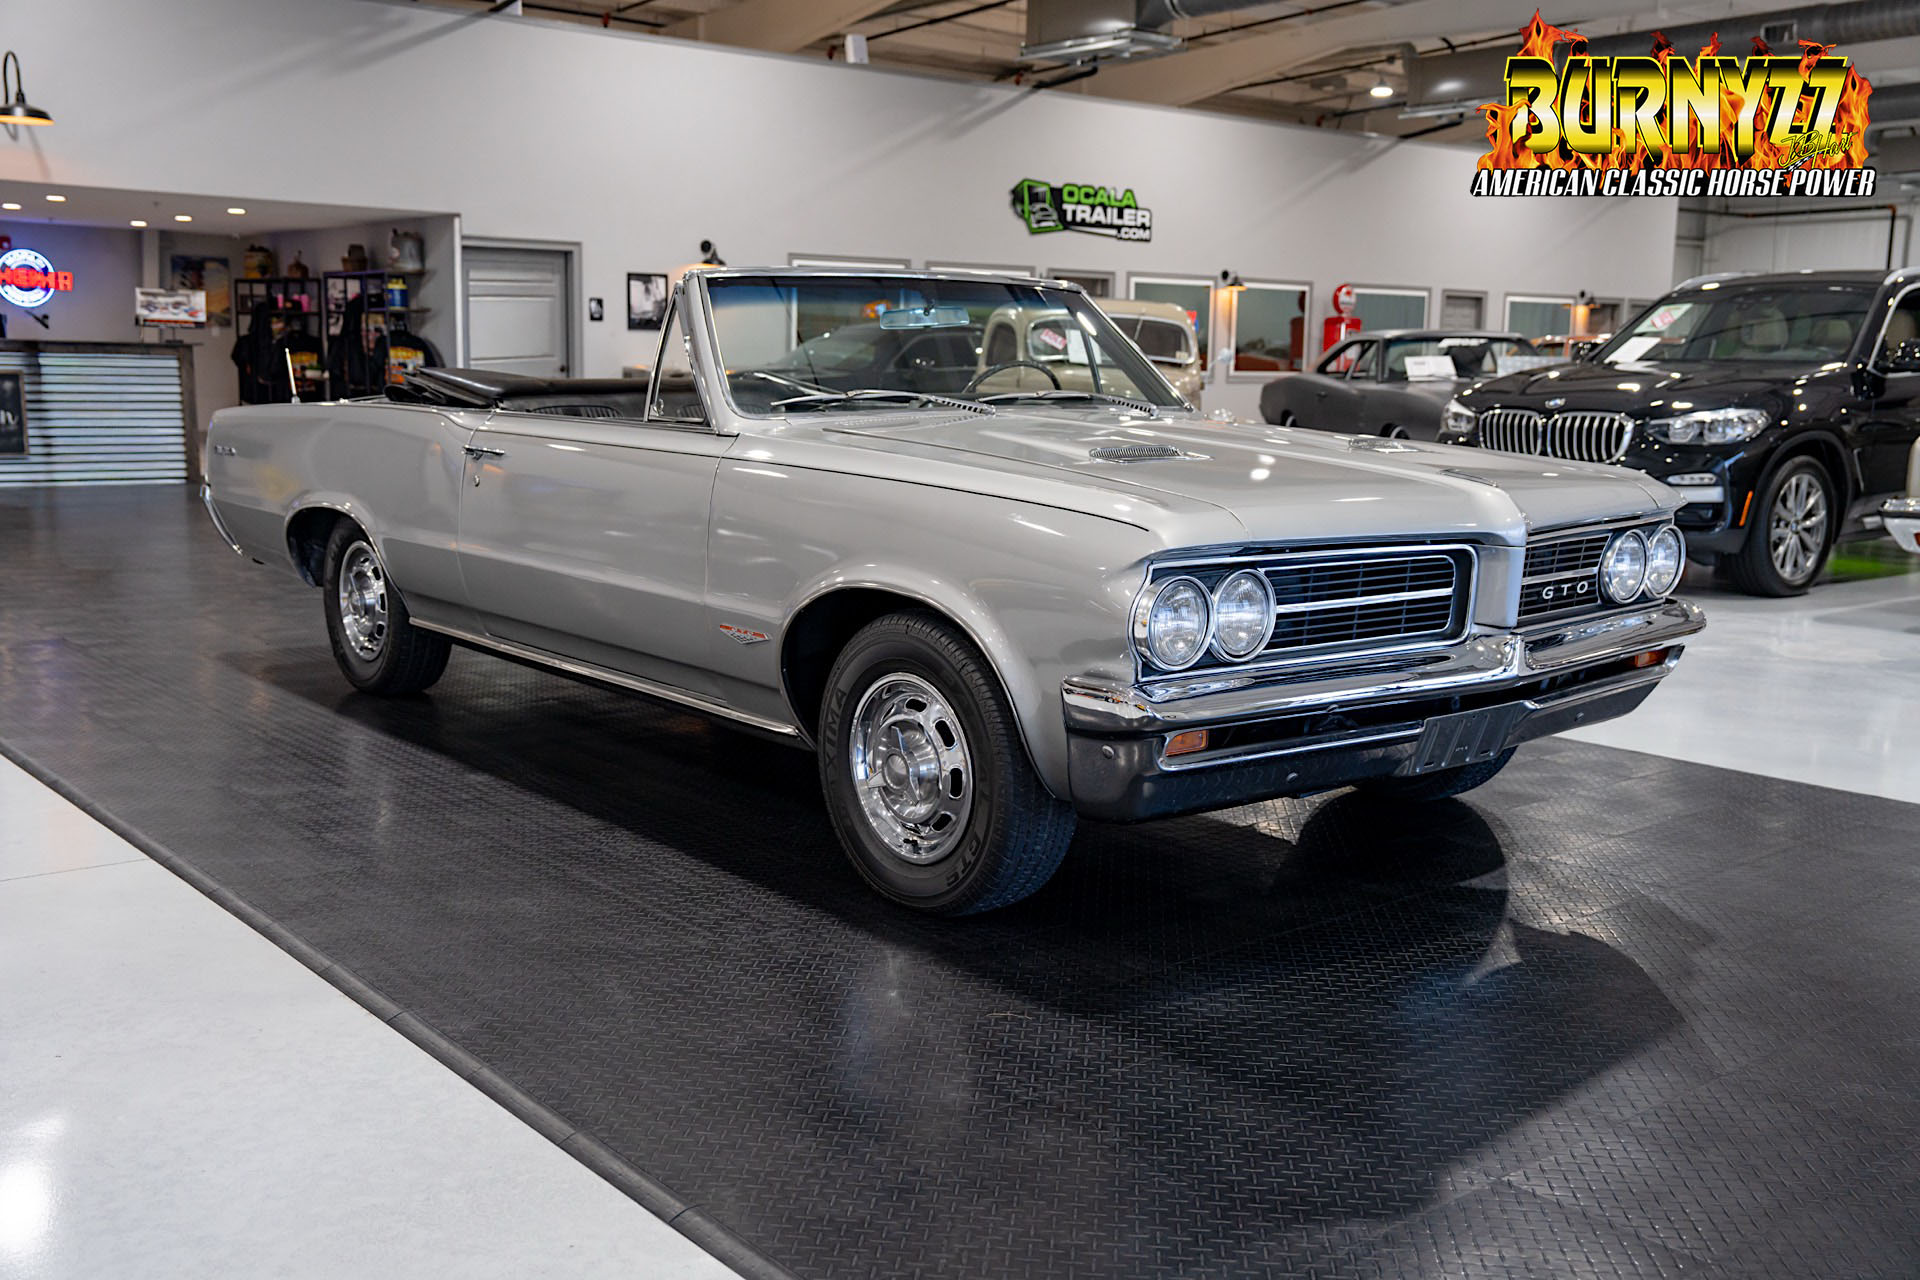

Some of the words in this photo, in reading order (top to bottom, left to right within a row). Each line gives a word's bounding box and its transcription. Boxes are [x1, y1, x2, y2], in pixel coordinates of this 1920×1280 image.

[1062, 185, 1137, 209] OCALA
[1062, 203, 1151, 227] TRAILER
[1117, 228, 1151, 240] .COM
[1542, 581, 1589, 600] GTO
